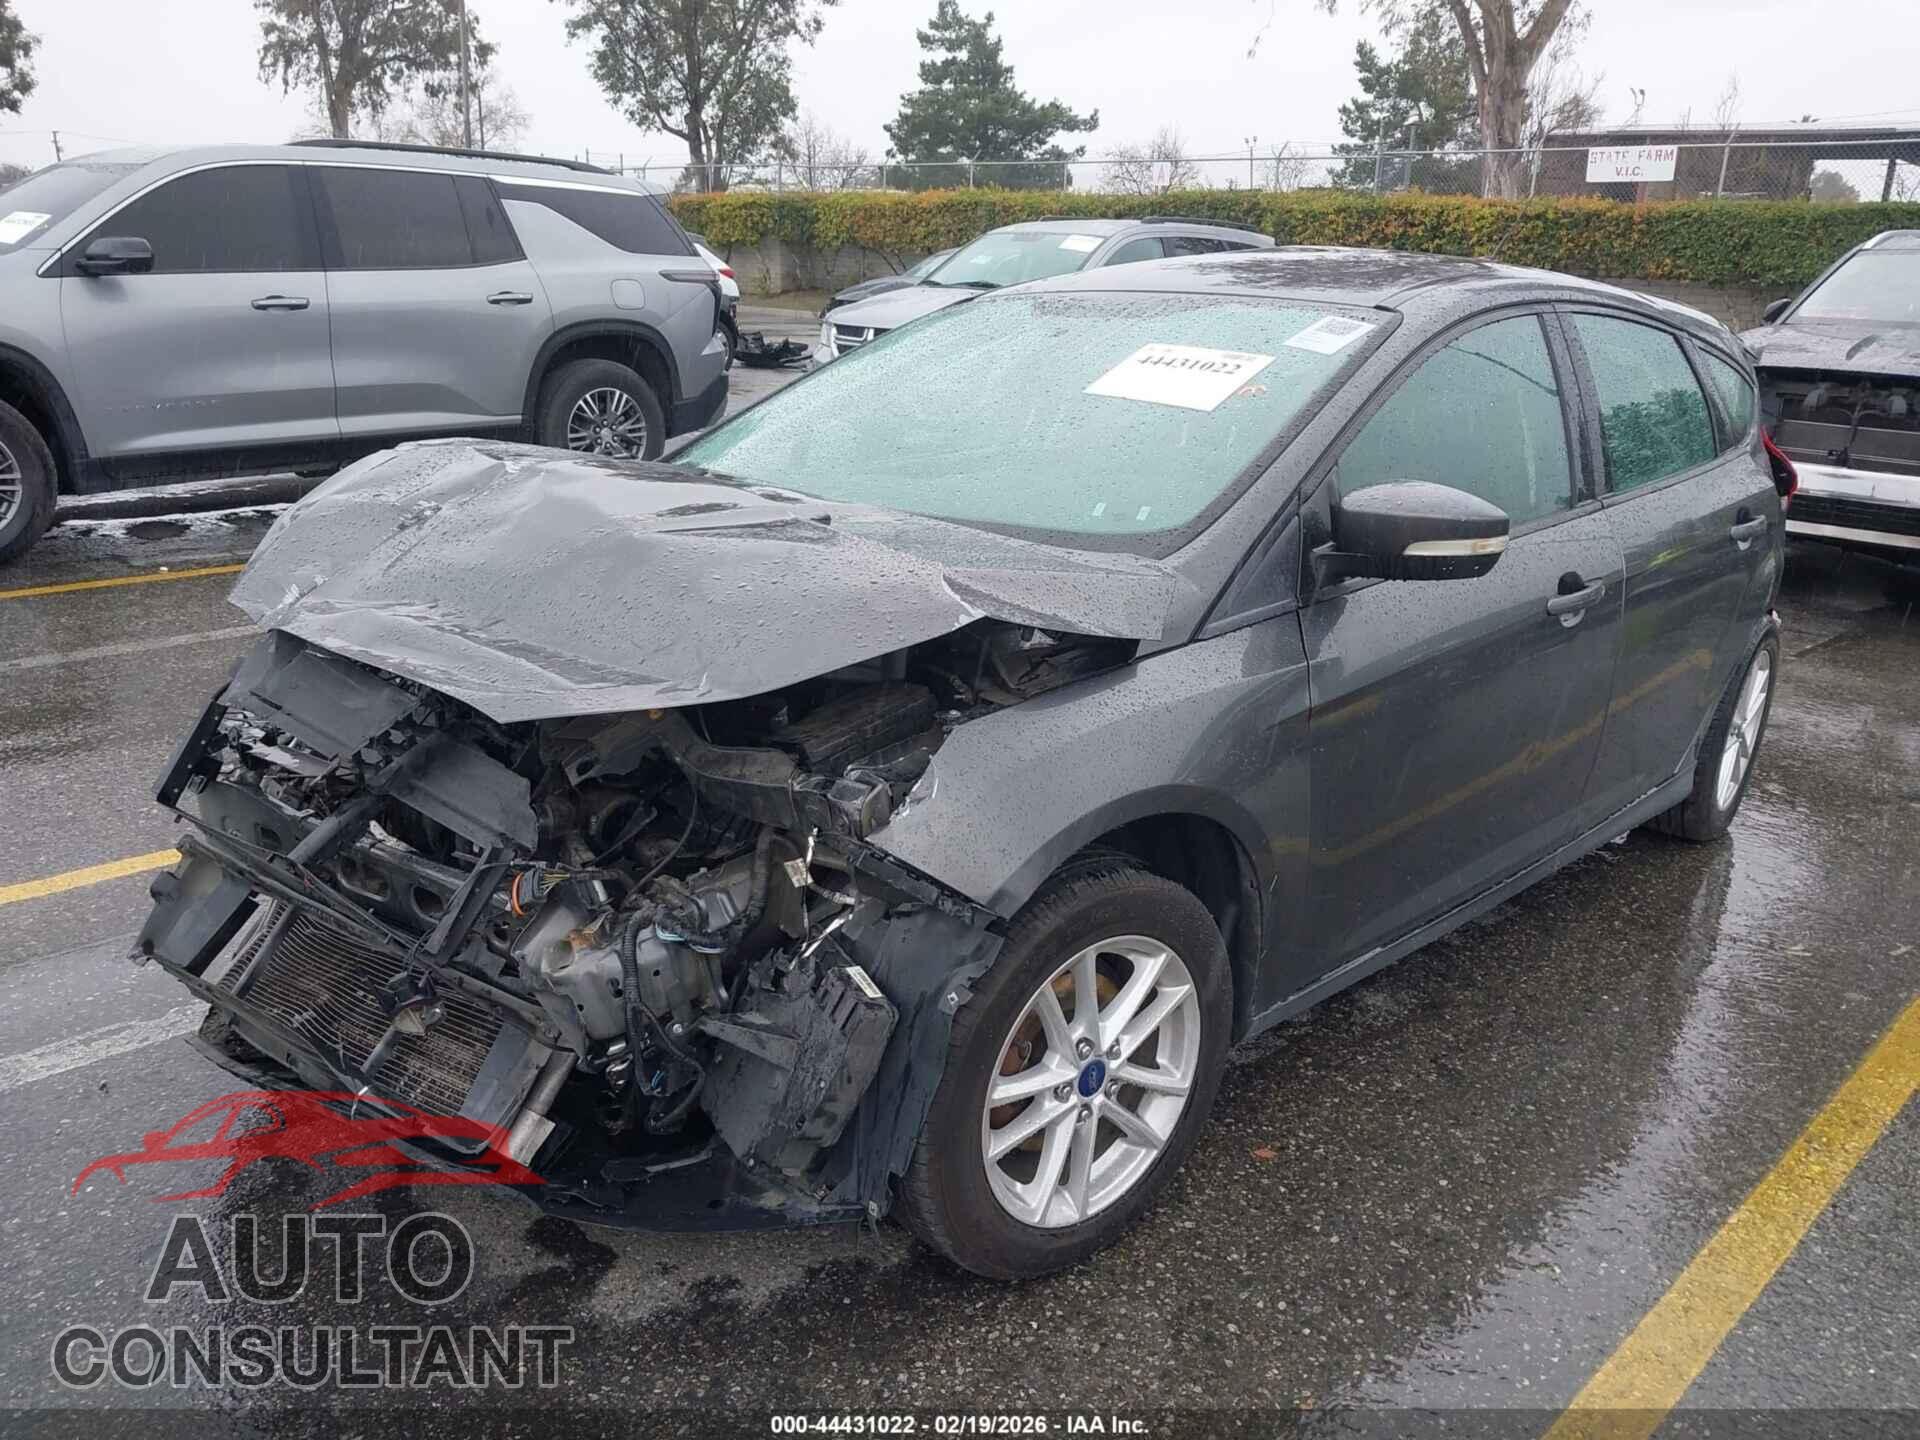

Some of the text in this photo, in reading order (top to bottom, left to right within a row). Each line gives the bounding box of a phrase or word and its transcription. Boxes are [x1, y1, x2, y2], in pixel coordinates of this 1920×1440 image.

[1589, 148, 1675, 164] STATE FARM
[1615, 165, 1644, 177] V.I.C.
[1137, 355, 1242, 375] 44431022
